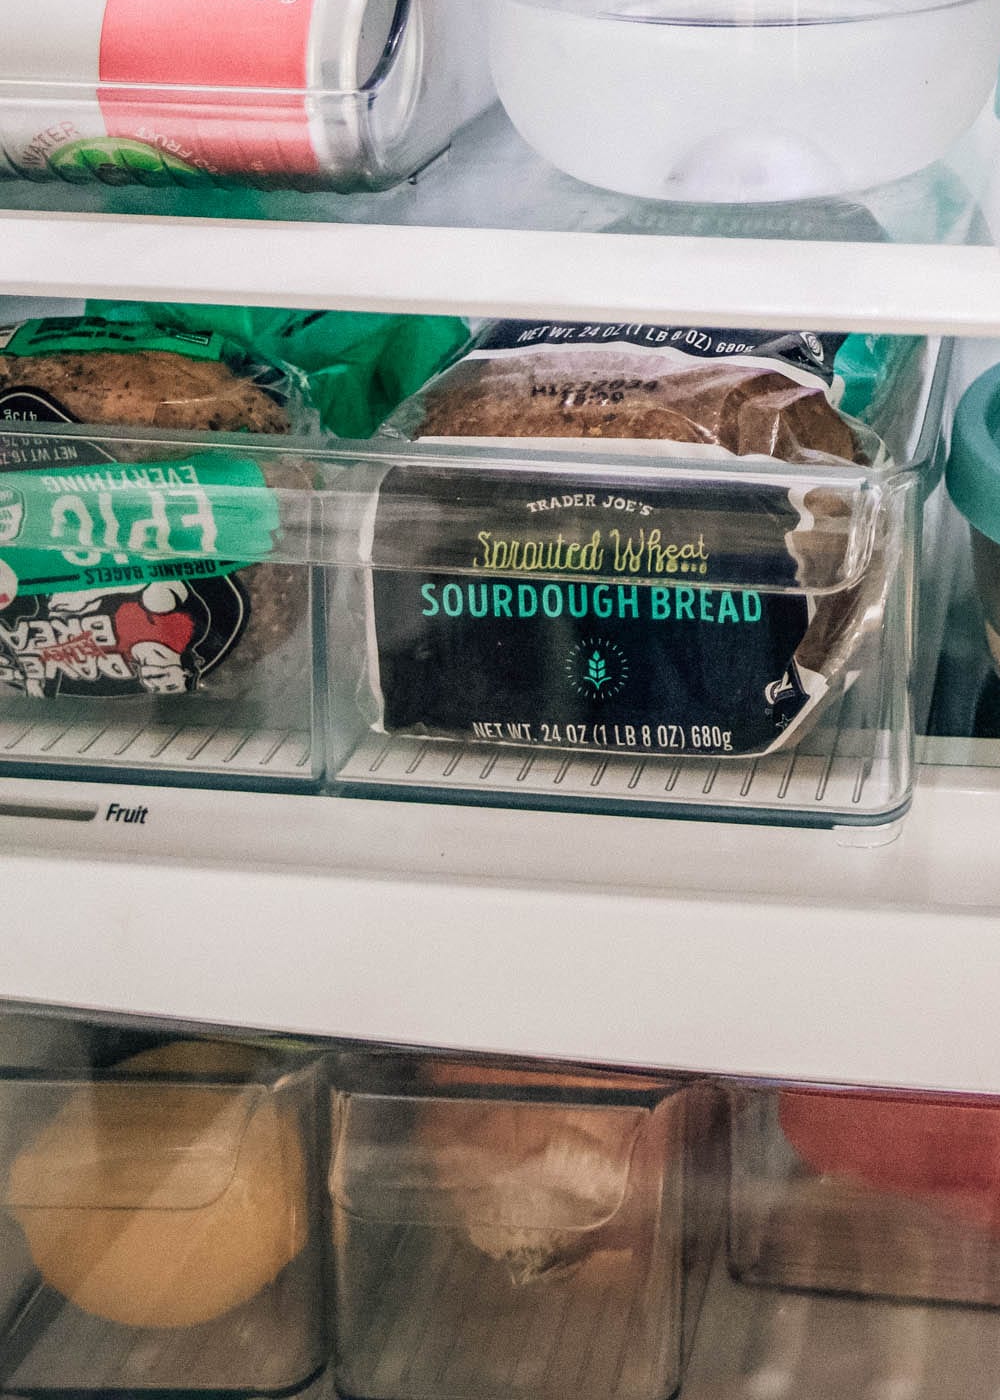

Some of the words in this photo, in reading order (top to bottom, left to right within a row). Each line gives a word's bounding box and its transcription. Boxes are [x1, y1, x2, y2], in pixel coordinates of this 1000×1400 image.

[517, 327, 546, 343] NET
[549, 325, 573, 339] WT.
[578, 326, 599, 338] 24
[603, 325, 625, 338] OZ
[645, 328, 666, 342] LB
[685, 330, 712, 352] OZ)
[30, 447, 51, 463] WT
[54, 445, 78, 461] NET
[41, 464, 198, 493] EVERYTHING
[527, 493, 596, 514] TRADER
[602, 493, 655, 517] JOE'S
[50, 488, 218, 566] EPIC
[473, 530, 604, 572] Sprouted
[608, 528, 710, 575] Wheat
[84, 564, 143, 585] BAGELS
[147, 560, 217, 578] ORGANIC
[421, 582, 640, 618] SOURDOUGH
[651, 585, 763, 625] BREAD
[472, 721, 506, 740] NET
[508, 722, 538, 744] WT.
[540, 723, 563, 744] 24
[566, 723, 589, 745] OZ
[594, 722, 608, 747] (1
[614, 726, 638, 746] LB
[642, 726, 652, 746] 8
[657, 726, 687, 749] OZ)
[691, 726, 732, 752] 680g
[106, 803, 149, 824] Fruit
